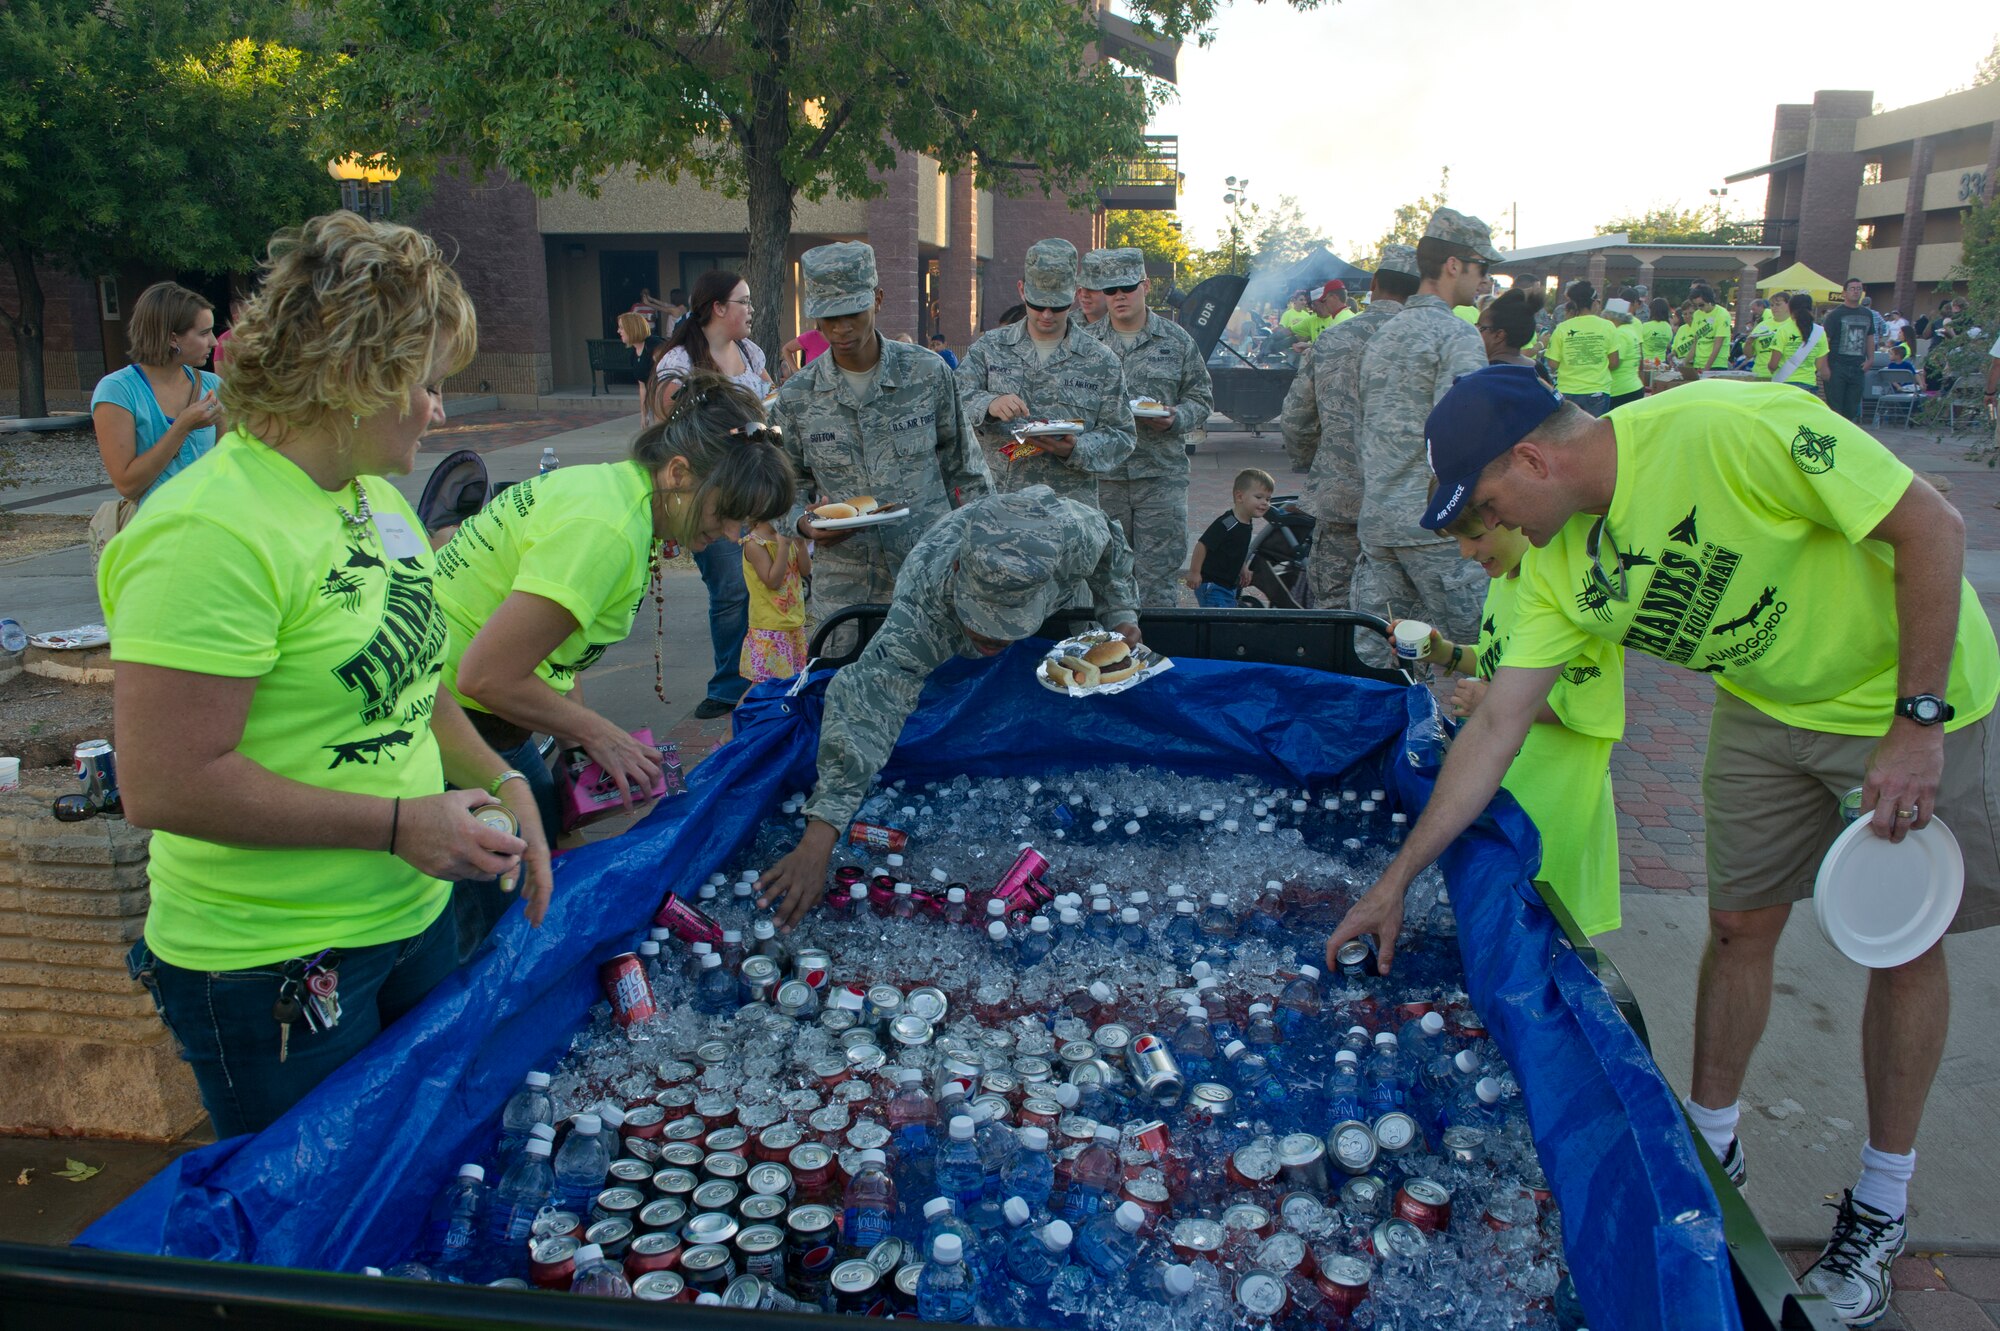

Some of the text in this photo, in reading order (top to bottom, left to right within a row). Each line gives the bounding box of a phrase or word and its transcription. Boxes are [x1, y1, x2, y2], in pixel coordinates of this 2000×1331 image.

[1197, 302, 1216, 326] ODR
[1064, 379, 1099, 391] U.S. AIR FORCE
[810, 431, 836, 444] SUTTON
[892, 413, 936, 432] U.S. AIR FORCE
[1436, 484, 1466, 522] AIR FORCE
[1682, 545, 1743, 642] HOLLOMAN
[1705, 600, 1789, 664] ALAMOGORDO
[1732, 632, 1778, 668] NEW MEXICO
[616, 967, 643, 998] BIG
[618, 980, 650, 1015] RED
